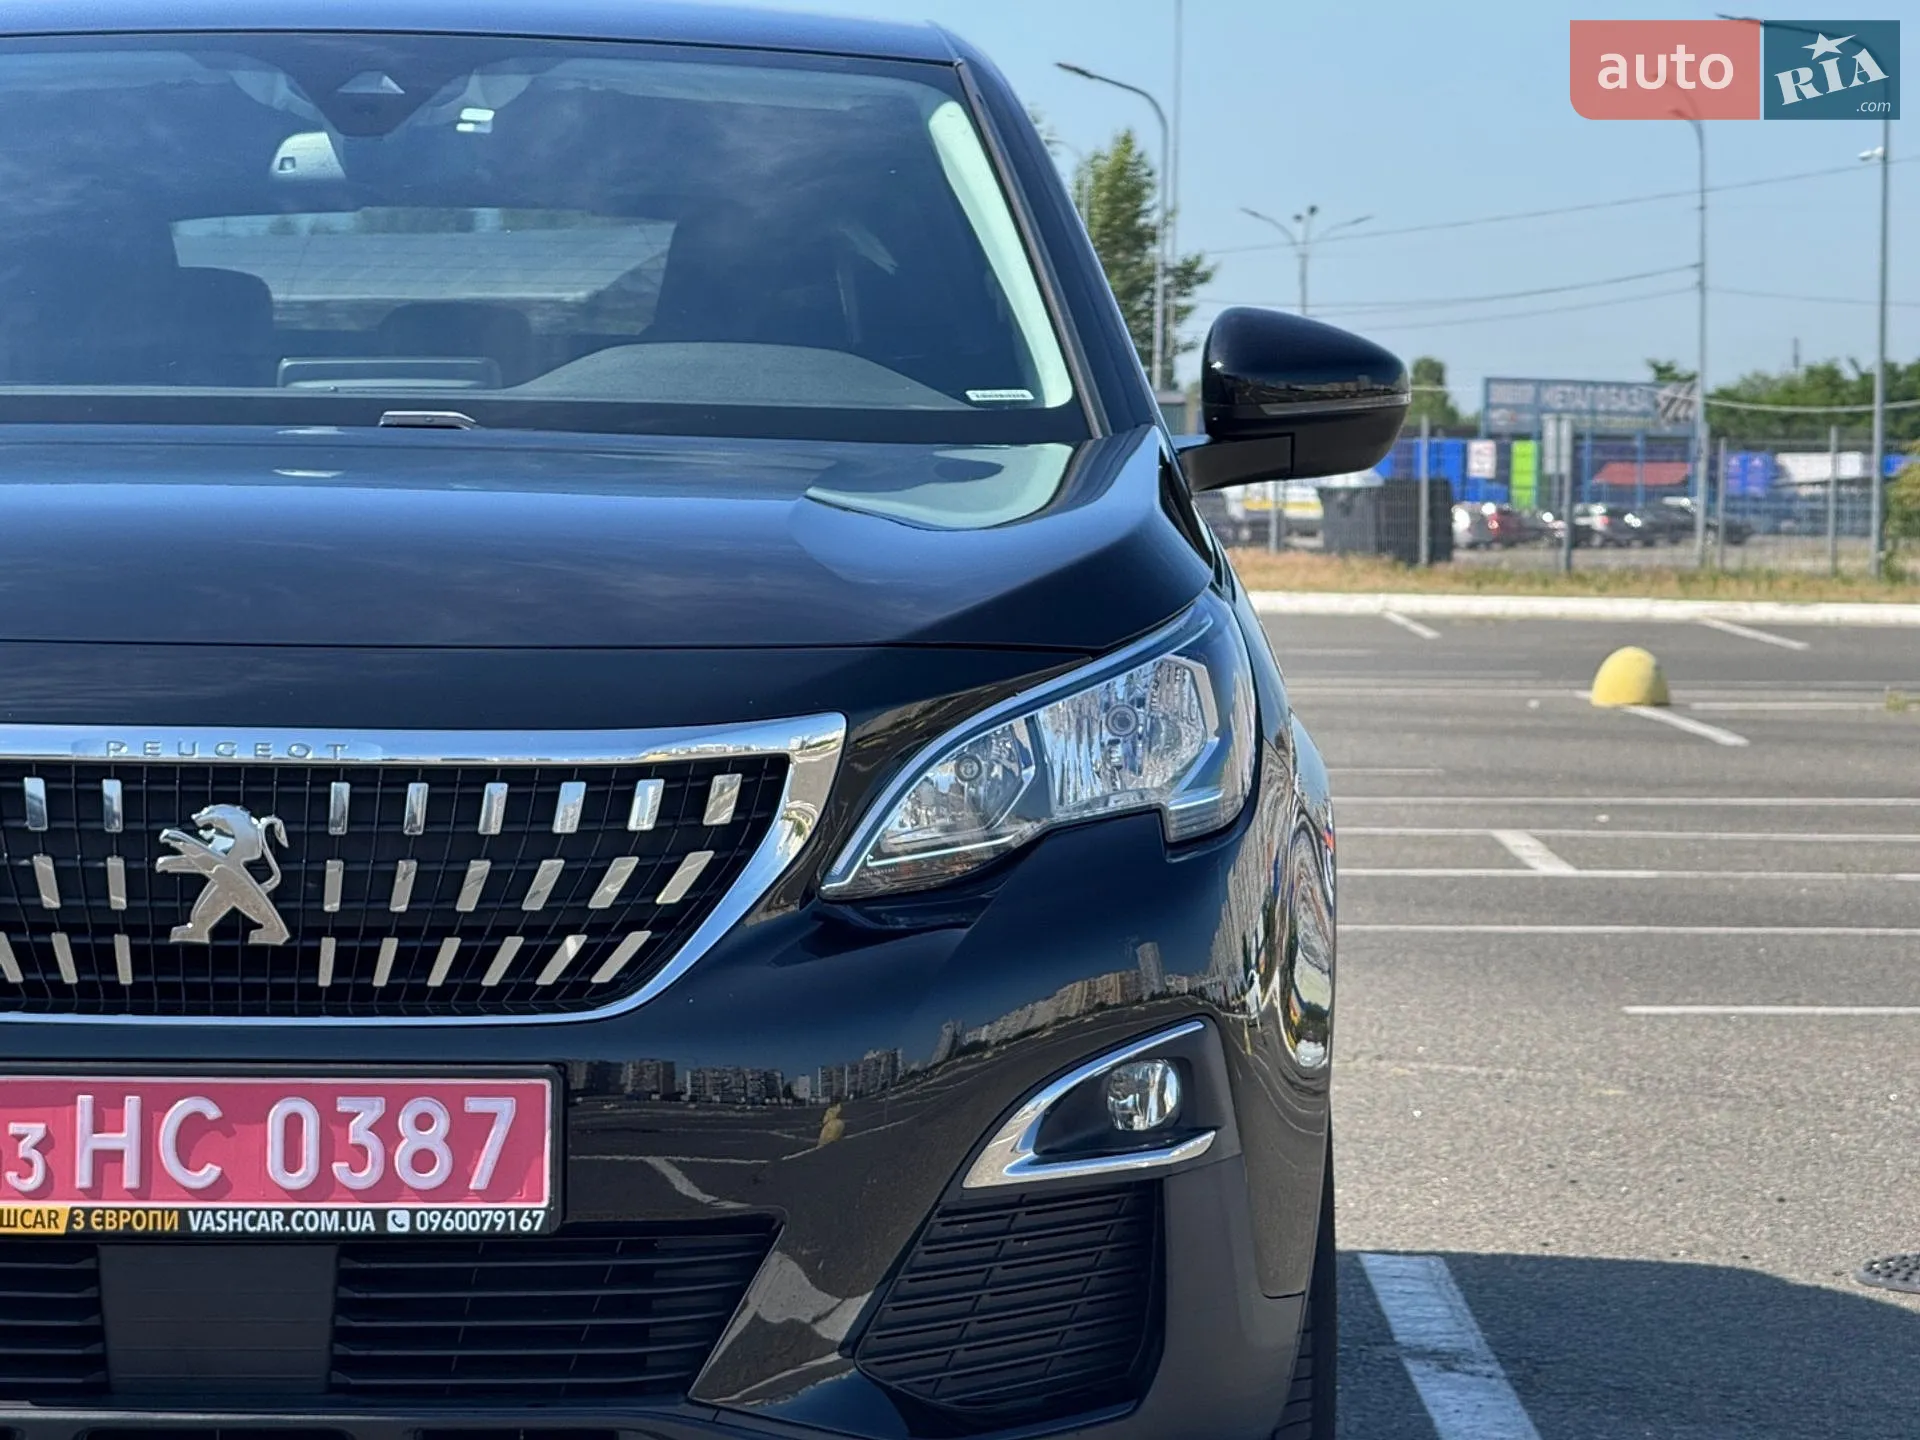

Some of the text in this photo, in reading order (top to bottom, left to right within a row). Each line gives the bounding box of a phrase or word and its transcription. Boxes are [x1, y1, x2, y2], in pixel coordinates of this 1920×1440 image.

[106, 740, 348, 758] PEUGEOT
[266, 1095, 517, 1191] 0387
[90, 1208, 179, 1231] ЄВРОПИ
[188, 1210, 545, 1232] VASHCAR.COM.UA 0960079167
